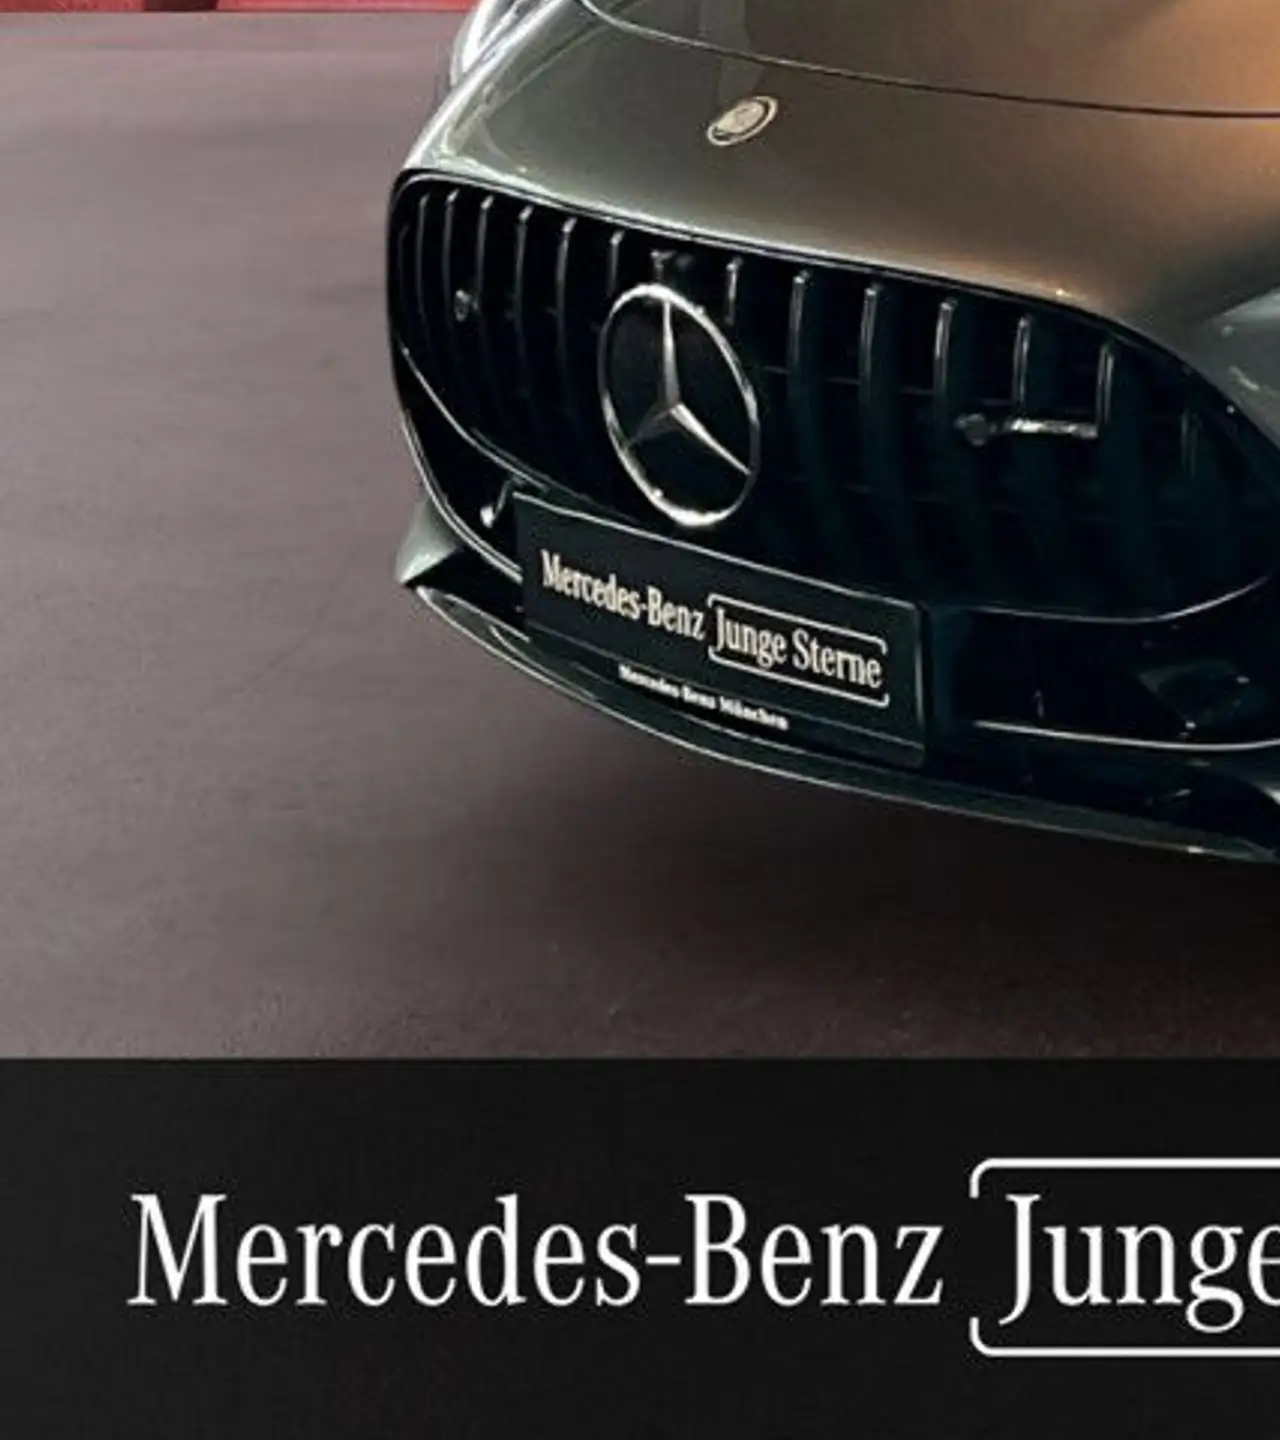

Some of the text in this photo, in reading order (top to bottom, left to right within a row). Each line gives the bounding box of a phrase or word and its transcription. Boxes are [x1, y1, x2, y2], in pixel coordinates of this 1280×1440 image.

[540, 548, 883, 690] Mercedes-Benz Junge Sterne
